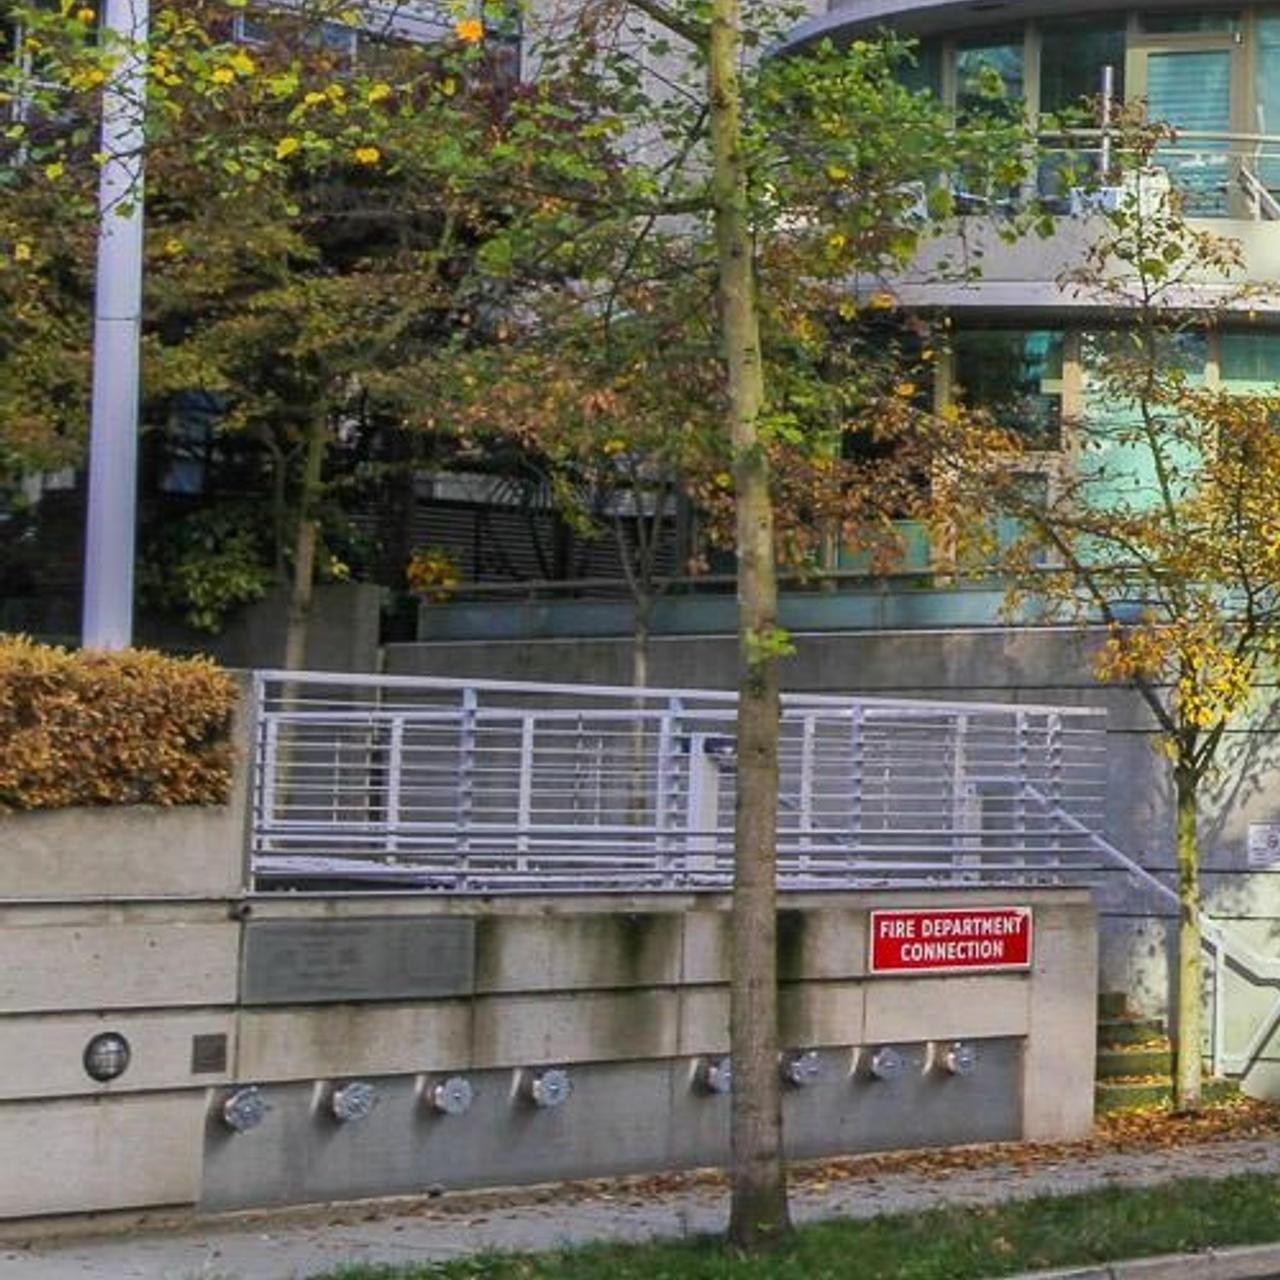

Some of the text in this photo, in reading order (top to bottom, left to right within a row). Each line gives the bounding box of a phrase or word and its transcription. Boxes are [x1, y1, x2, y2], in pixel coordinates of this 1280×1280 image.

[880, 917, 1022, 938] FIRE DEPARTMENT
[900, 941, 1004, 961] CONNECTION
